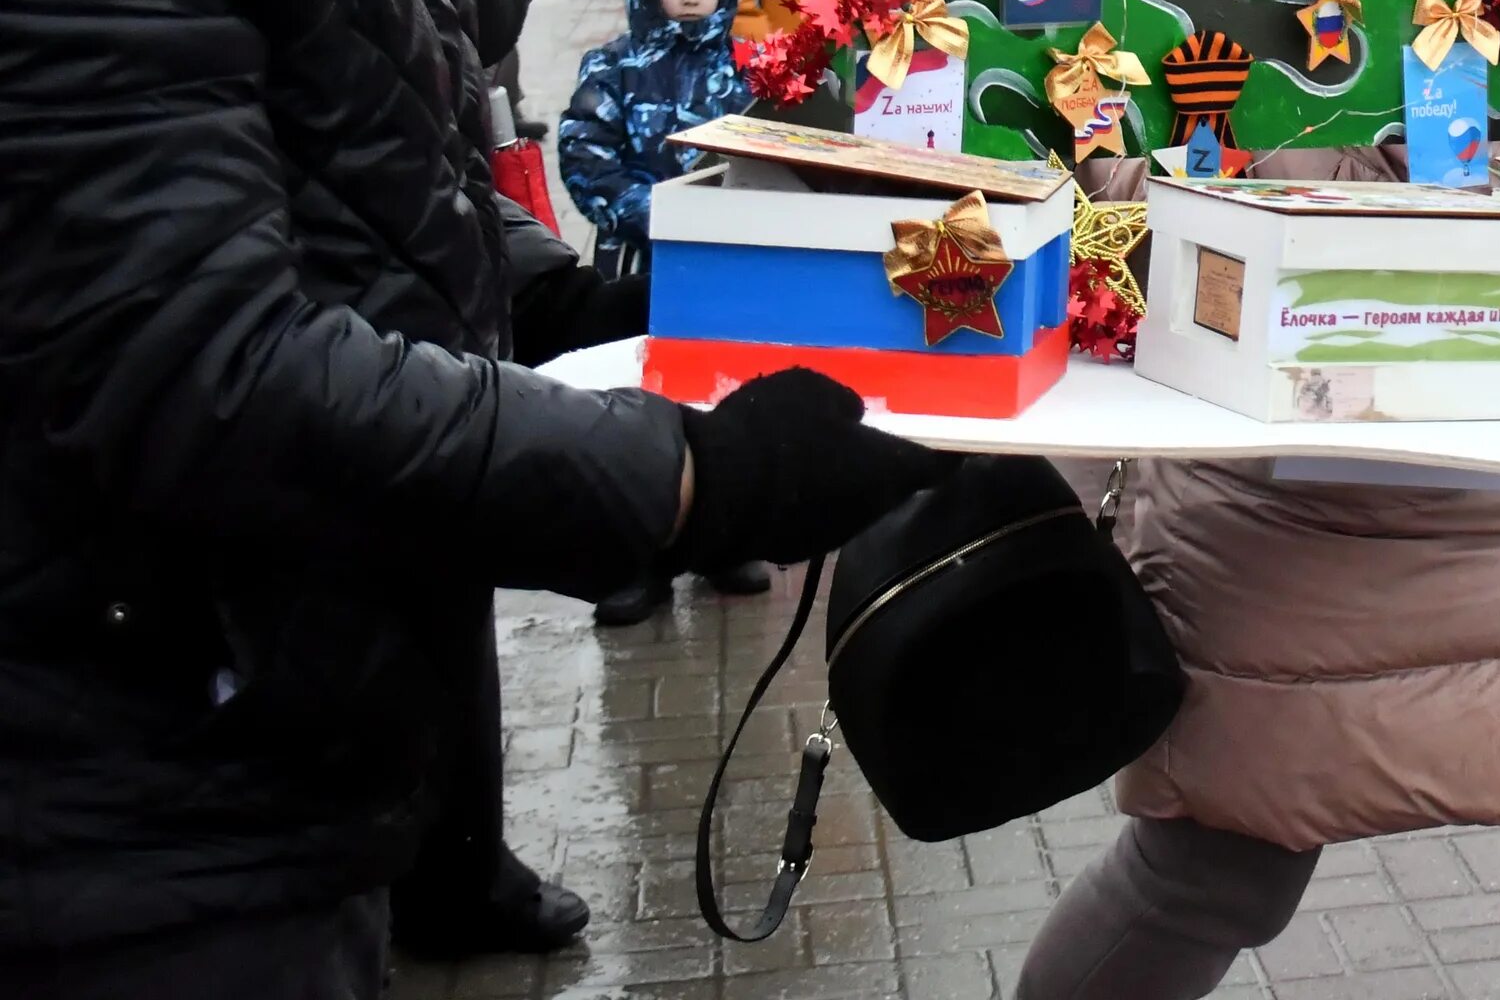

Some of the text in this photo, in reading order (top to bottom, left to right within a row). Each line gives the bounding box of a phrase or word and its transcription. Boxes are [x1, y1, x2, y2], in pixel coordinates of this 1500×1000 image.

[907, 100, 952, 114] наших!
[1411, 100, 1457, 118] победу!
[1191, 149, 1213, 172] Z
[1281, 308, 1336, 327] Ёлочка
[1364, 311, 1421, 327] героям
[1426, 310, 1484, 326] каждая
